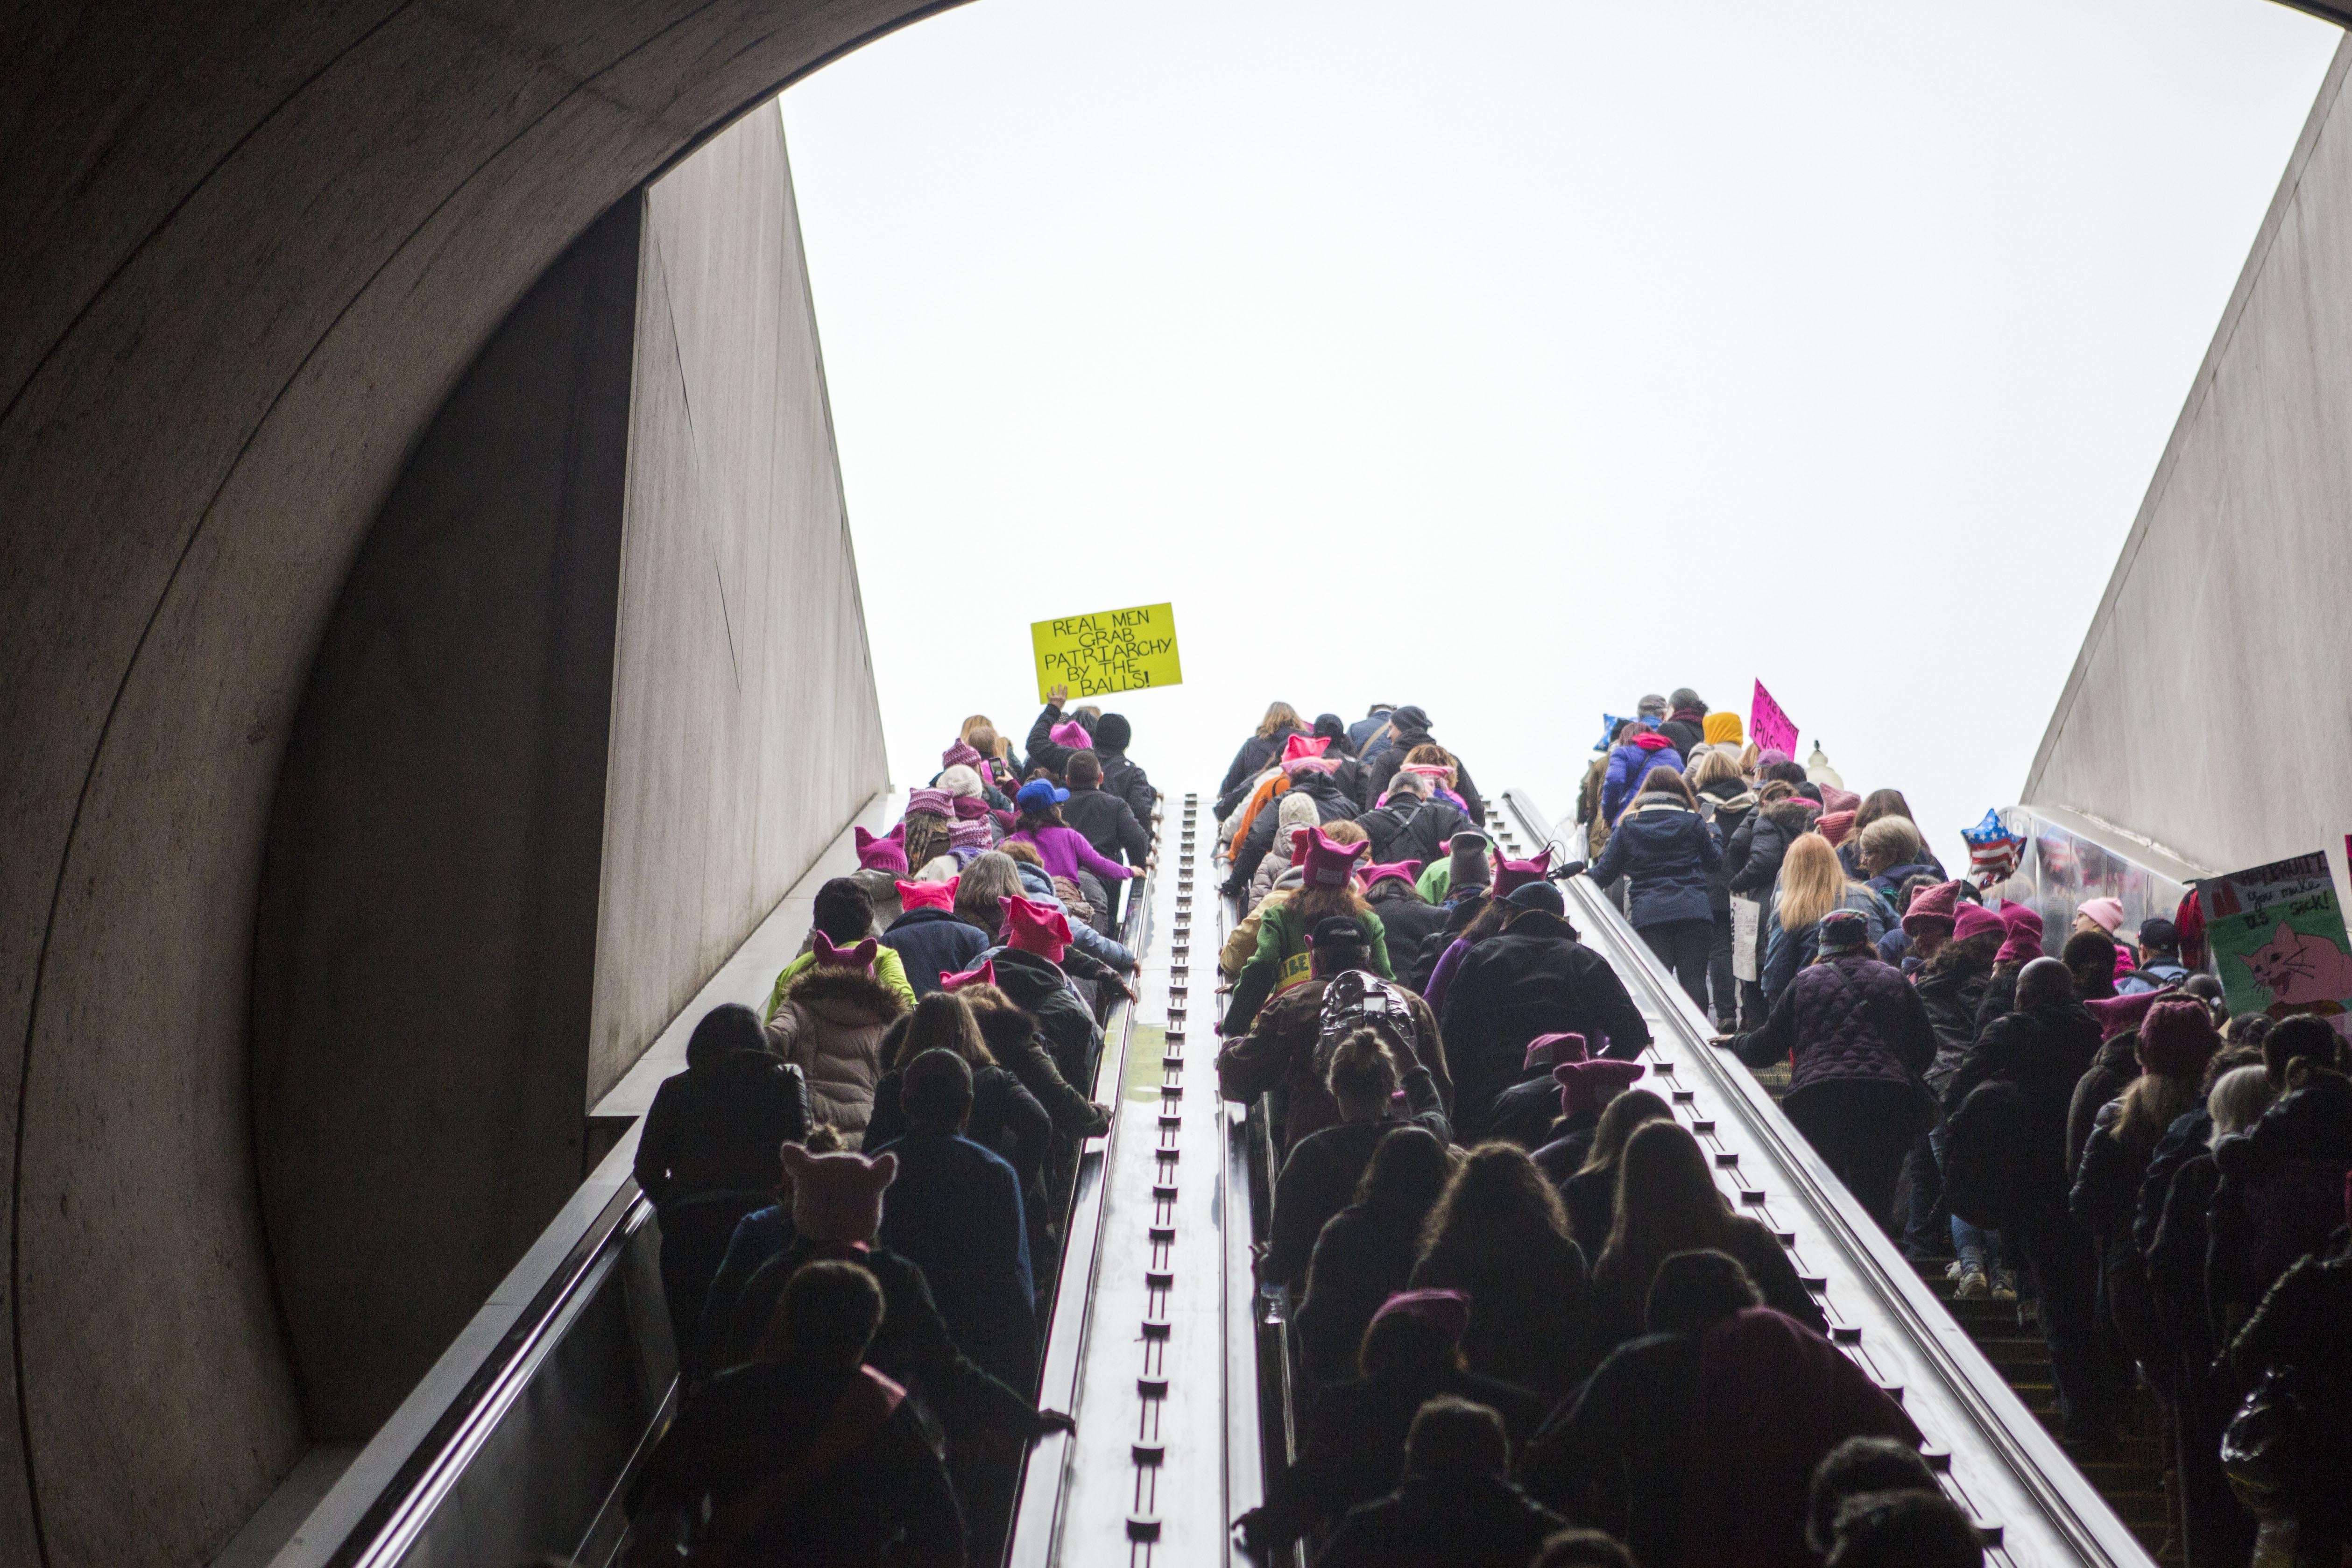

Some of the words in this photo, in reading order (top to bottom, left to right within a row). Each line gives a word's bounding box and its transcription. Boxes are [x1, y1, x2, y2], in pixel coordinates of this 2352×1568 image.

[1053, 616, 1105, 637] REAL
[1112, 609, 1149, 628] MEN
[1079, 628, 1134, 648] GRAB
[1045, 638, 1172, 670] PATRIARCHY
[1067, 665, 1089, 682] BY
[1099, 658, 1140, 676] THE
[1081, 671, 1150, 697] BALLS!
[1758, 684, 1777, 714] GRAB
